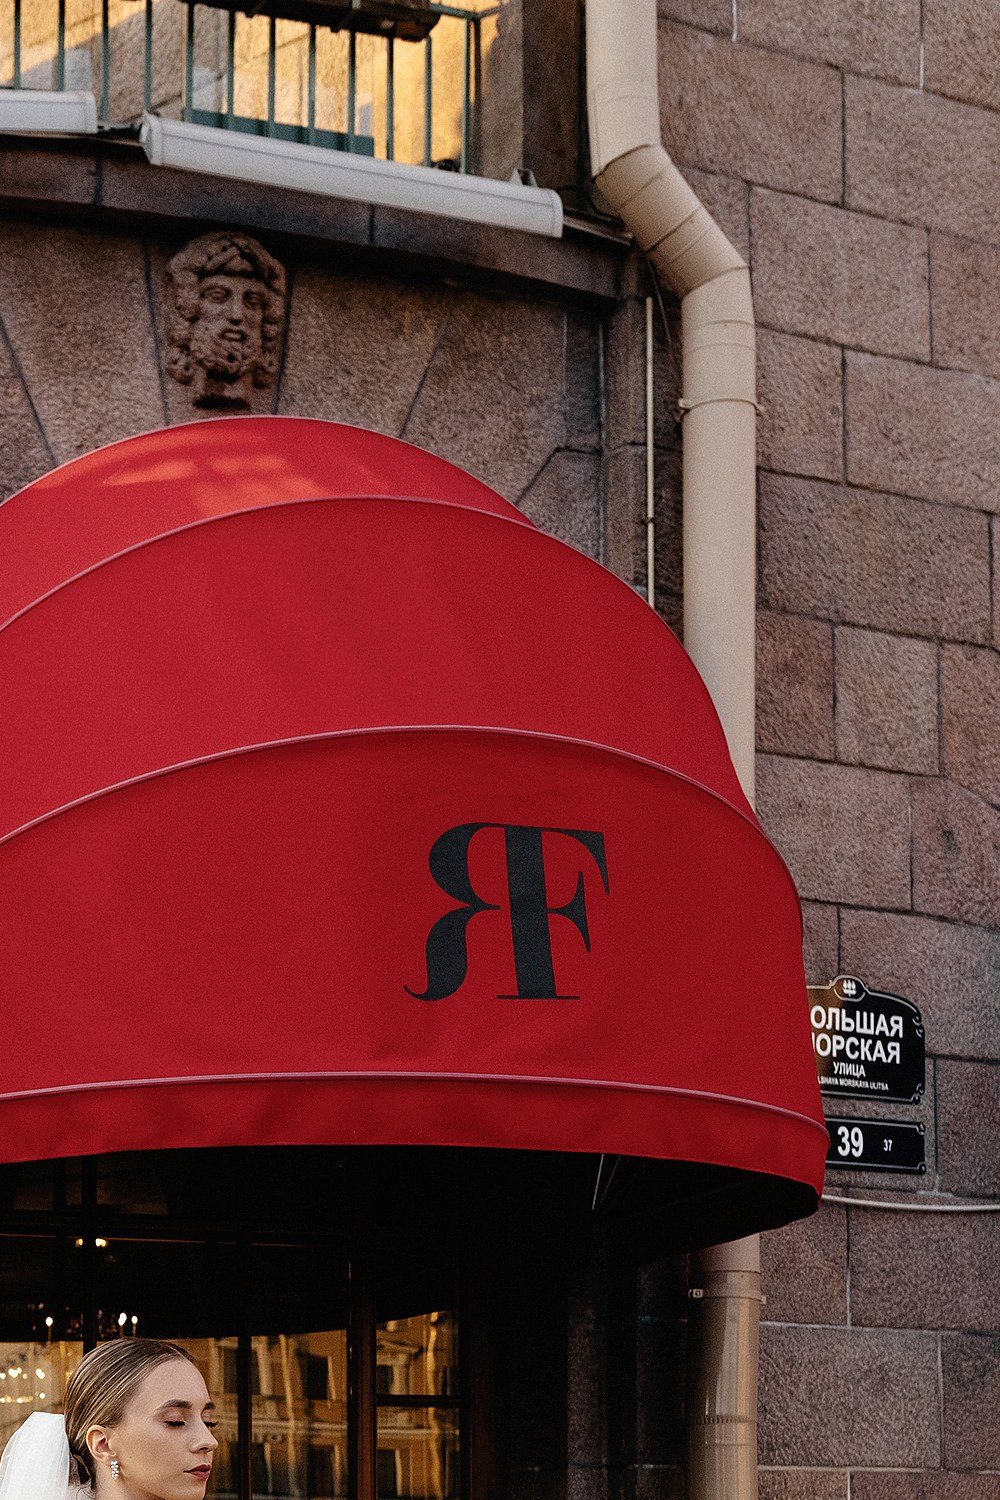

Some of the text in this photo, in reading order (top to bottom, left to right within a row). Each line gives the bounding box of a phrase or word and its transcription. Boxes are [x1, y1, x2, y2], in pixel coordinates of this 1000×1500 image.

[809, 1005, 904, 1039] ОЛЬШАЯ
[811, 1032, 901, 1065] ОРСКАЯ
[832, 1061, 867, 1079] УЛИЦА
[837, 1125, 864, 1158] 39
